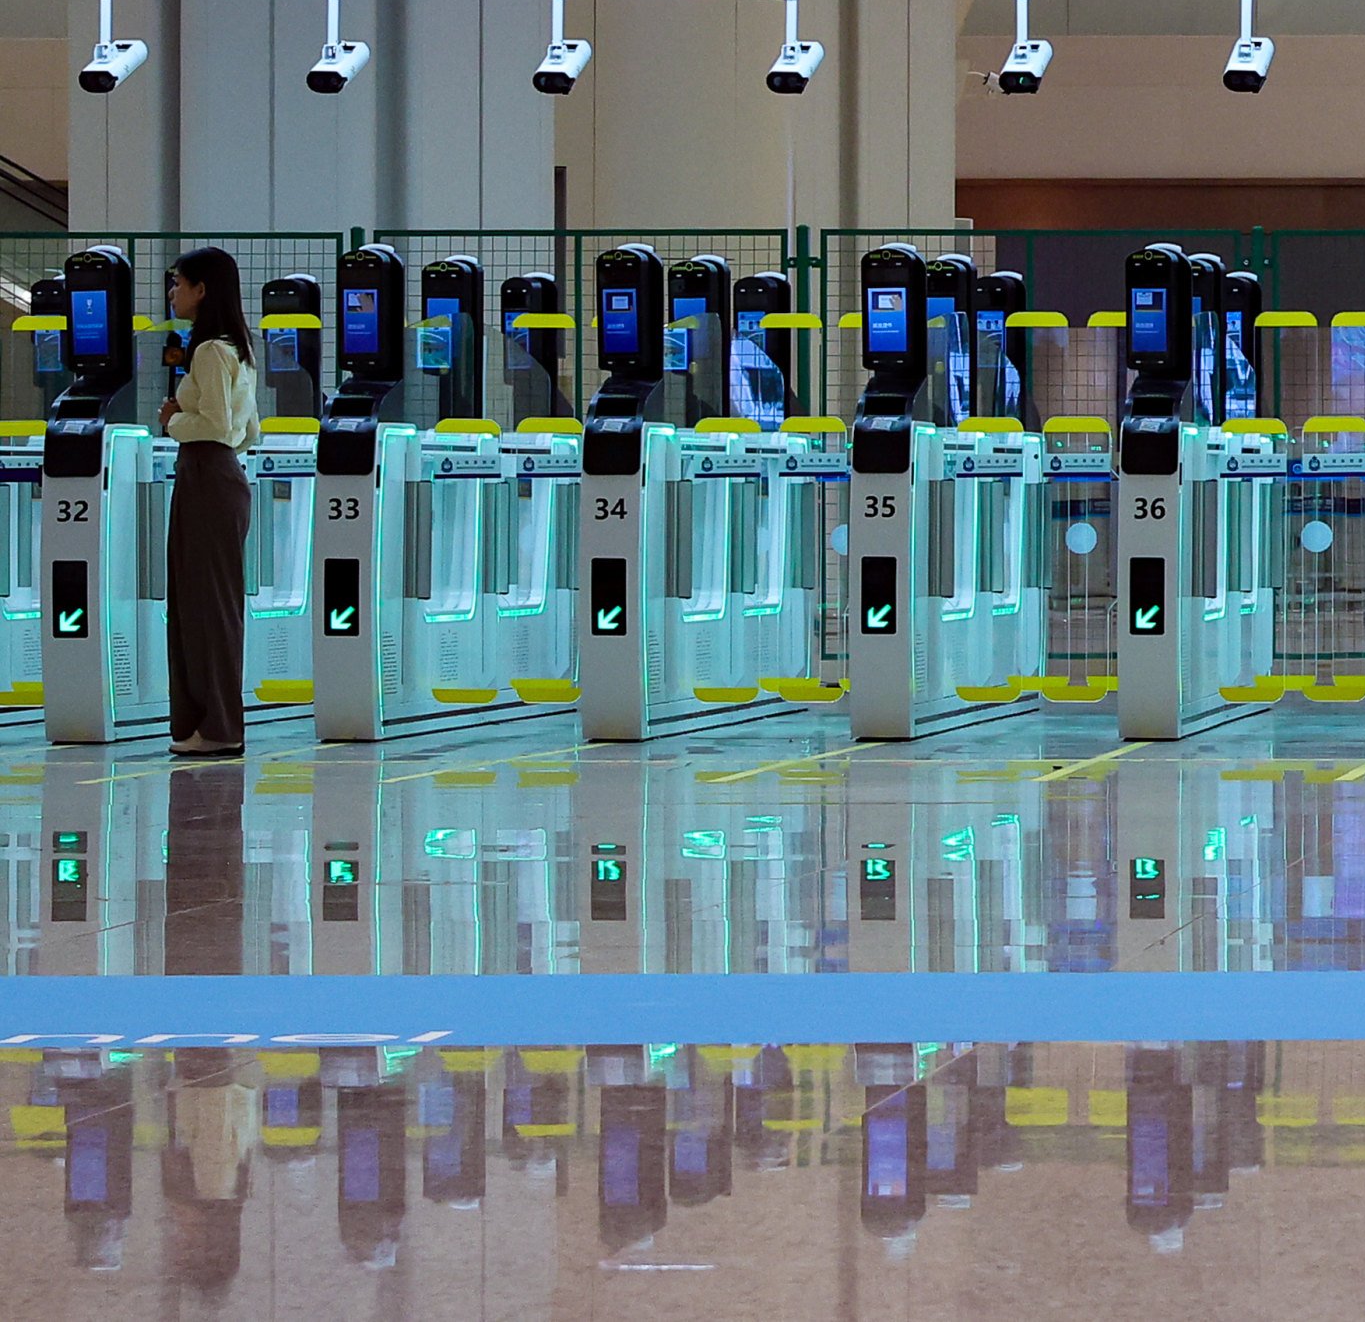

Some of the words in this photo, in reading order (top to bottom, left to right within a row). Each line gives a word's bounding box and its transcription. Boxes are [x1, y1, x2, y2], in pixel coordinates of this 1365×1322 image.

[56, 499, 89, 523] 32
[328, 497, 360, 521] 33
[594, 497, 628, 521] 34
[864, 495, 896, 518] 35
[1133, 497, 1166, 520] 36
